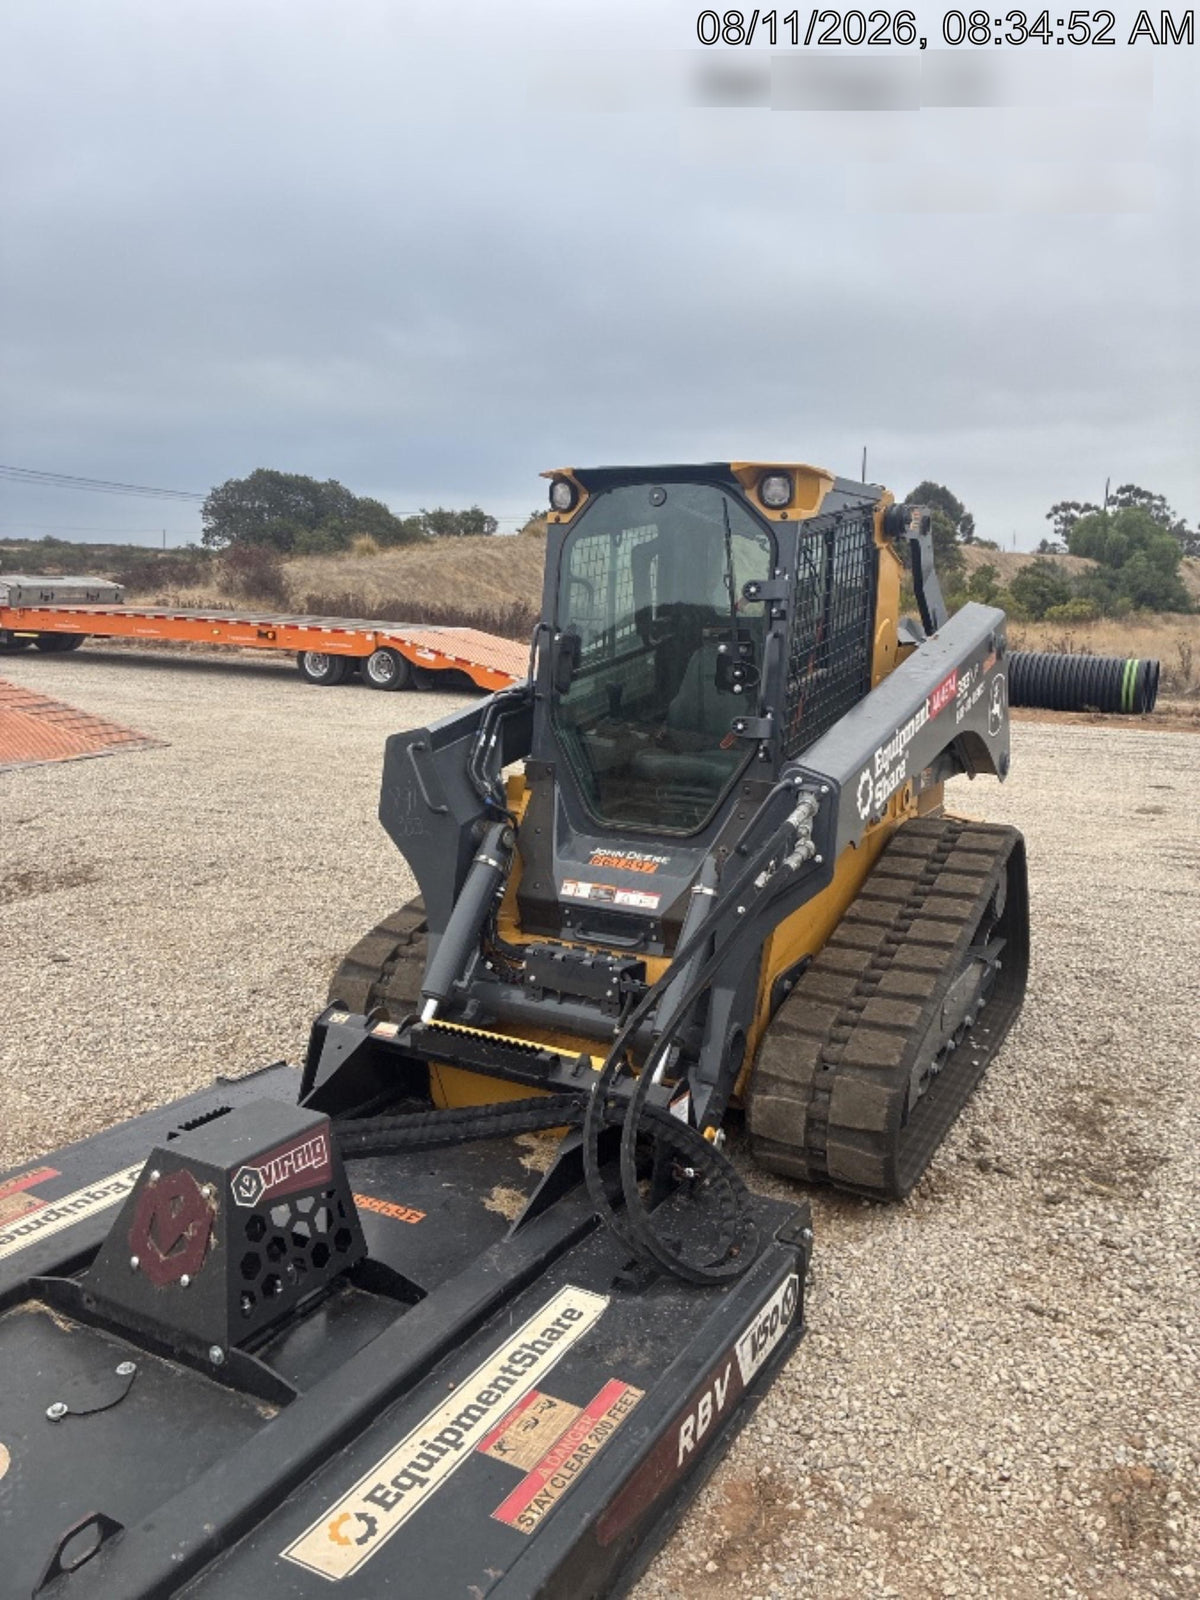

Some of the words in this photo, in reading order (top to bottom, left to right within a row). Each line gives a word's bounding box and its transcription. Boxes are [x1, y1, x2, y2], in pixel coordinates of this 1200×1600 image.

[874, 698, 931, 779] Equipment
[874, 757, 906, 810] Share
[590, 847, 625, 858] JOHN
[626, 851, 671, 865] DEERE
[363, 1307, 584, 1512] EquipmentShare
[546, 1415, 598, 1468] DANGER
[677, 1362, 732, 1468] RBV
[518, 1488, 555, 1527] STAY
[551, 1443, 596, 1489] CLEAR
[589, 1420, 614, 1443] 200
[607, 1389, 641, 1421] FEET
